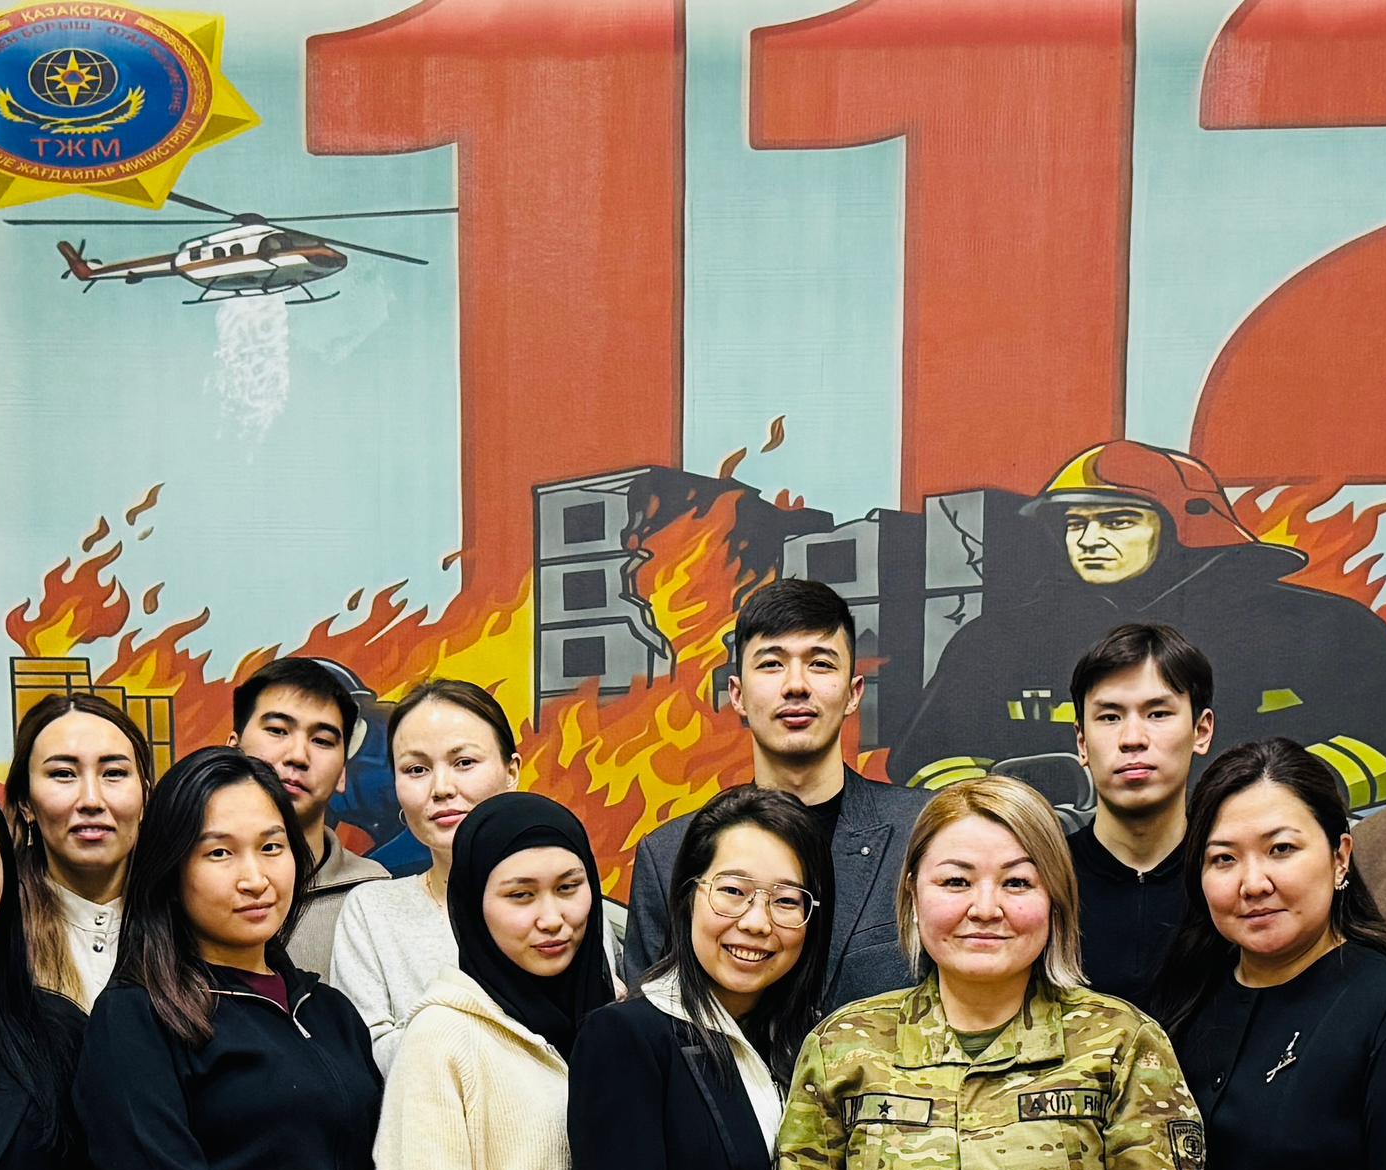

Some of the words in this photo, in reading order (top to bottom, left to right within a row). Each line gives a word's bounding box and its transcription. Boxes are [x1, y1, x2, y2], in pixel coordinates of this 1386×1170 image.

[20, 4, 126, 22] ҚАЗАҚСТАН
[21, 19, 92, 38] БОРЫШ
[30, 137, 121, 159] ТЖМ
